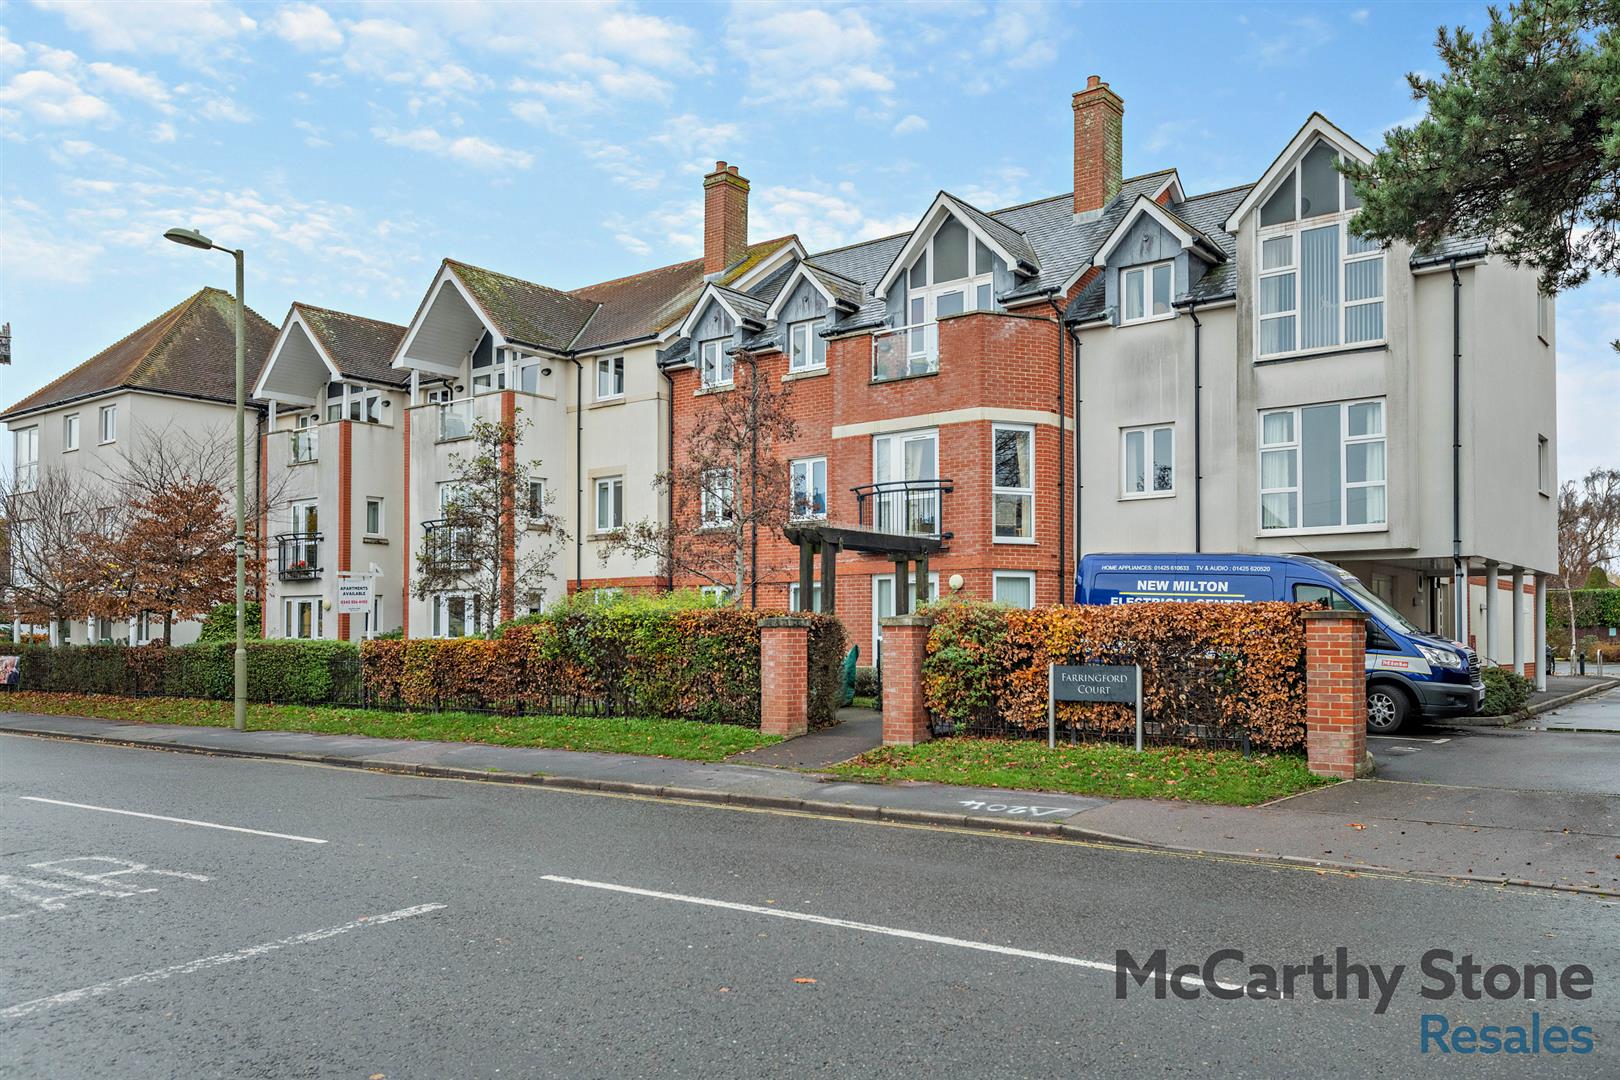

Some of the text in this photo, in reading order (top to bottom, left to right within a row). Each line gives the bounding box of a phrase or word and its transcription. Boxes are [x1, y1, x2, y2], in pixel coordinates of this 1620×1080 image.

[1137, 580, 1229, 592] NEW MILTON
[1061, 672, 1128, 683] FARRINGFORD
[1077, 684, 1111, 695] COURT
